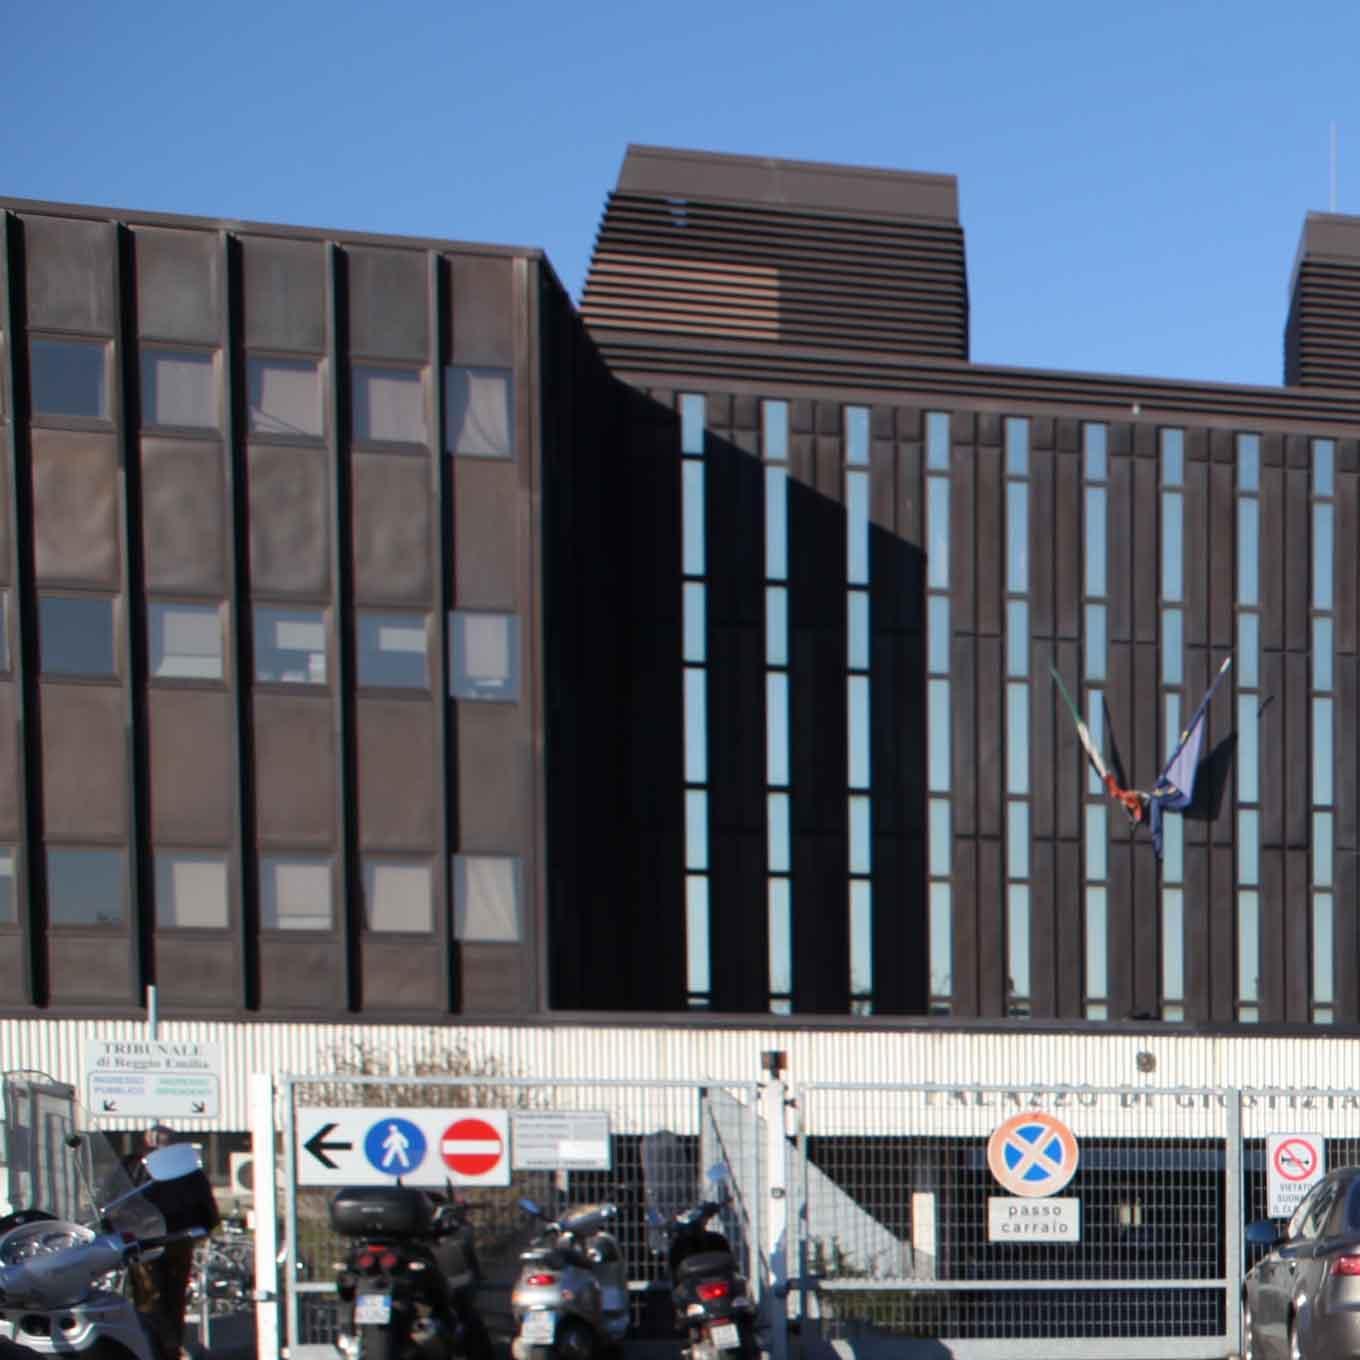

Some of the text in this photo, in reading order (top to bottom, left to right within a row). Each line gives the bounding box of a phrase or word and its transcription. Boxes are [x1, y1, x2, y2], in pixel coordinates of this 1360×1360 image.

[103, 1042, 203, 1056] TRIBUNALE
[1008, 1205, 1062, 1219] passo
[1001, 1219, 1069, 1233] carraio
